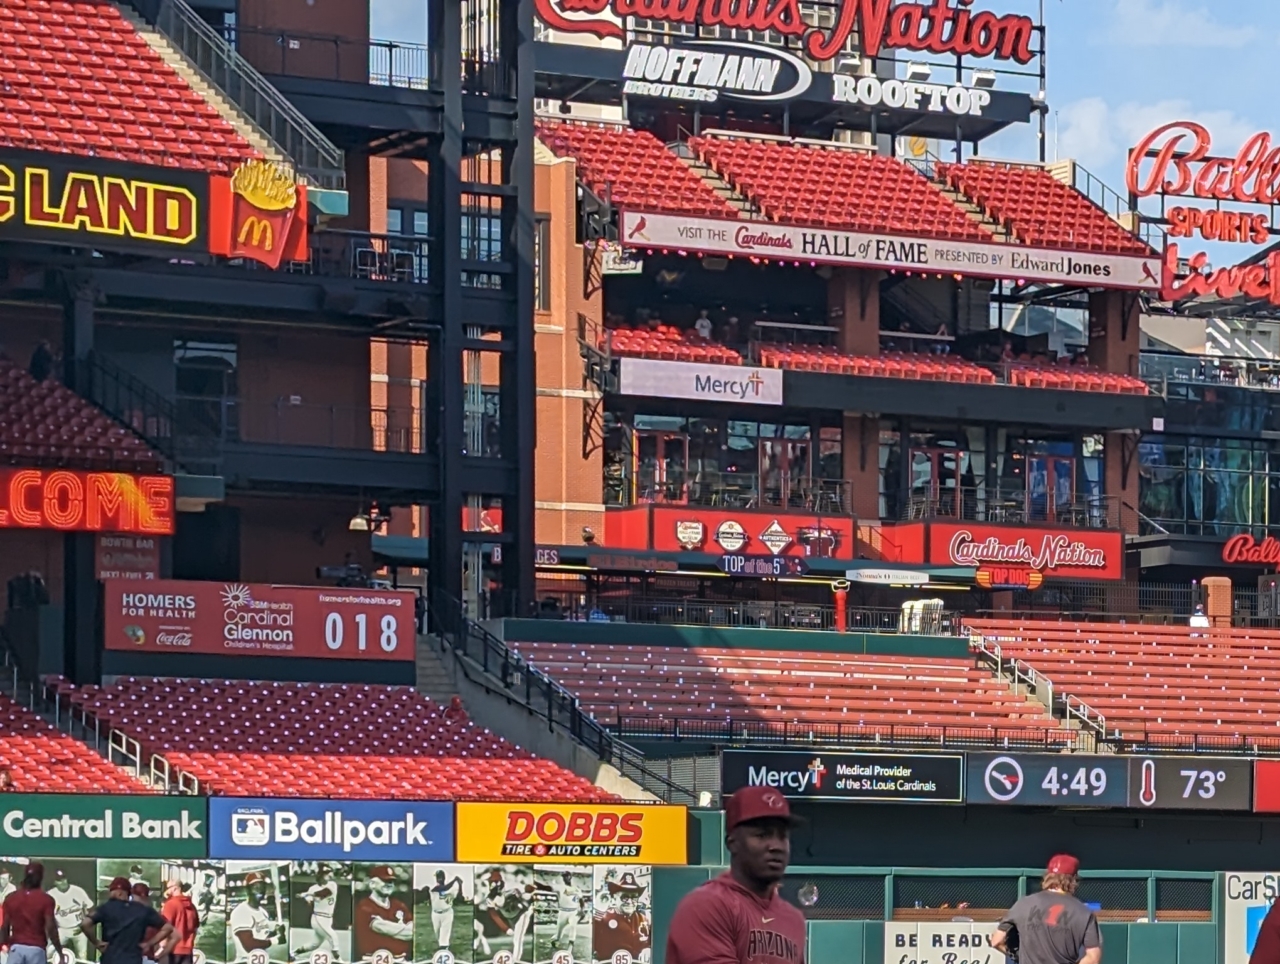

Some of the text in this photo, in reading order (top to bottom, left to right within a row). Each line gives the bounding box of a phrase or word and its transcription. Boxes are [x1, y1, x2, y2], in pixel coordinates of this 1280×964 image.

[806, 0, 1036, 65] Nation
[623, 44, 781, 92] HOFFMANN
[623, 80, 719, 102] BROTHERS
[833, 74, 991, 116] ROOFTOP
[25, 167, 196, 244] LAND
[1167, 206, 1269, 244] SPORTS
[677, 226, 1111, 277] VISIT THE Cardinals HALL of FAME PRESENTED BY Edward Jones
[695, 374, 749, 399] Mercy
[136, 537, 153, 549] BAR
[950, 530, 1104, 569] Cardinals Nation
[723, 556, 745, 573] TOP
[744, 560, 755, 573] of
[756, 559, 772, 574] the
[989, 568, 1029, 584] TOP DOG
[122, 593, 195, 609] HOMERS
[319, 594, 401, 606] homersforhealth.org
[122, 608, 195, 619] FOR HEALTH
[223, 608, 293, 626] Cardinal
[223, 624, 293, 642] Glennon
[224, 640, 293, 651] Children's Hospital
[749, 766, 810, 791] Mercy
[837, 764, 912, 777] Medical Provider
[836, 779, 845, 789] of
[846, 779, 860, 790] the
[873, 780, 895, 790] Louis
[897, 780, 936, 792] Cardinals
[1041, 767, 1107, 796] 4:49
[1180, 770, 1226, 798] 73°
[3, 809, 202, 839] Central Bank
[275, 811, 428, 852] Ballpark
[505, 811, 644, 842] DOBBS
[506, 844, 637, 856] TIRE & AUTO CENTERS
[895, 933, 992, 948] BE READY
[251, 954, 265, 964] 20
[314, 953, 328, 964] 23
